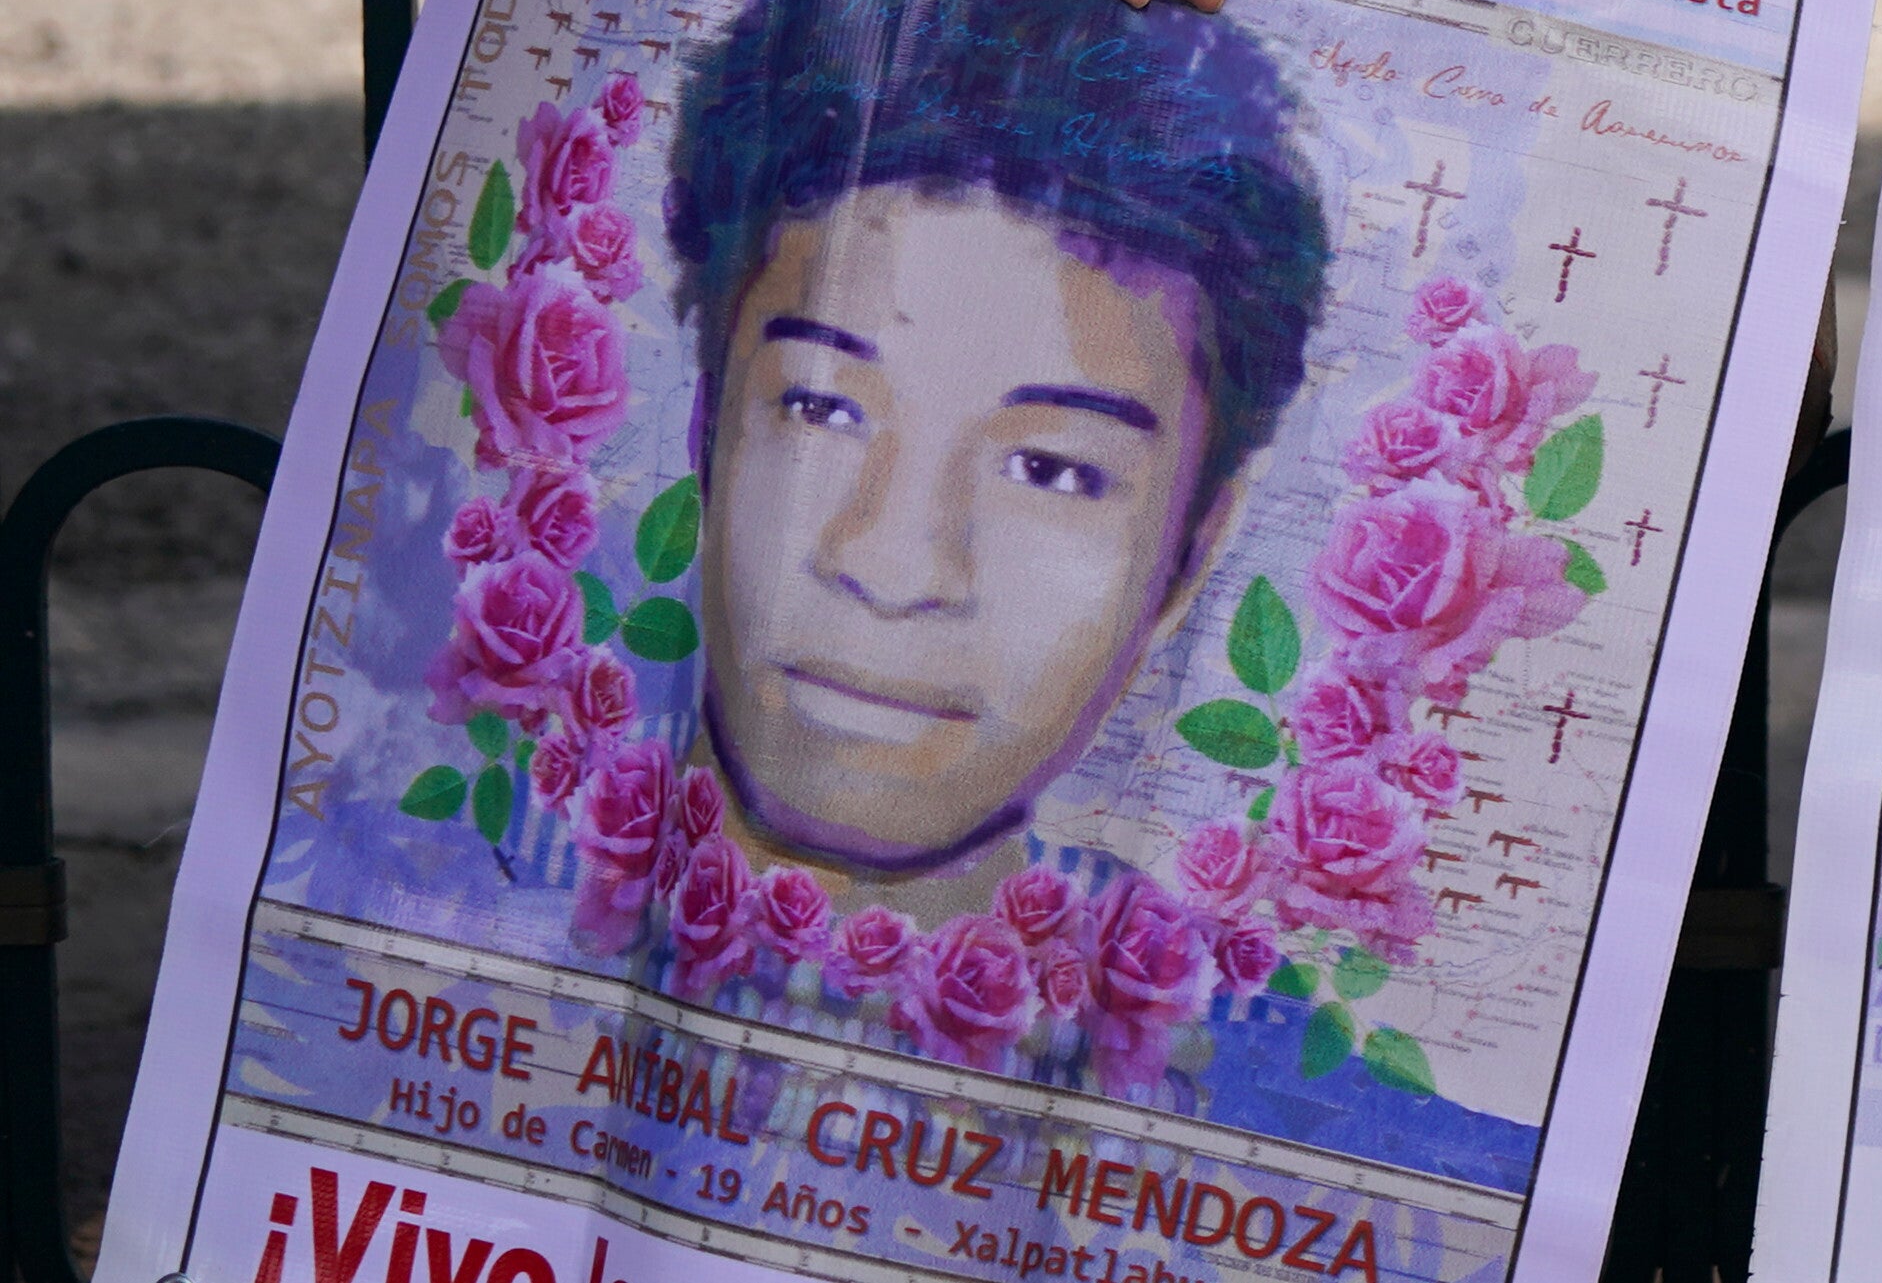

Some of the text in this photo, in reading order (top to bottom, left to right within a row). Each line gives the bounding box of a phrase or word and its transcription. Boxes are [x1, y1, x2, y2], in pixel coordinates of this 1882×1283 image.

[1503, 15, 1763, 106] GUERRERO
[1529, 93, 1562, 119] de
[287, 397, 398, 822] AYOTZINAPA
[387, 148, 469, 350] SOMOS
[339, 978, 1381, 1283] JORGE ANÍBAL CRUZ MENDOZA
[390, 1077, 480, 1134] Hijo
[503, 1102, 547, 1145] de
[570, 1118, 653, 1181] Carmen
[695, 1163, 743, 1205] 19
[761, 1179, 872, 1237] Años
